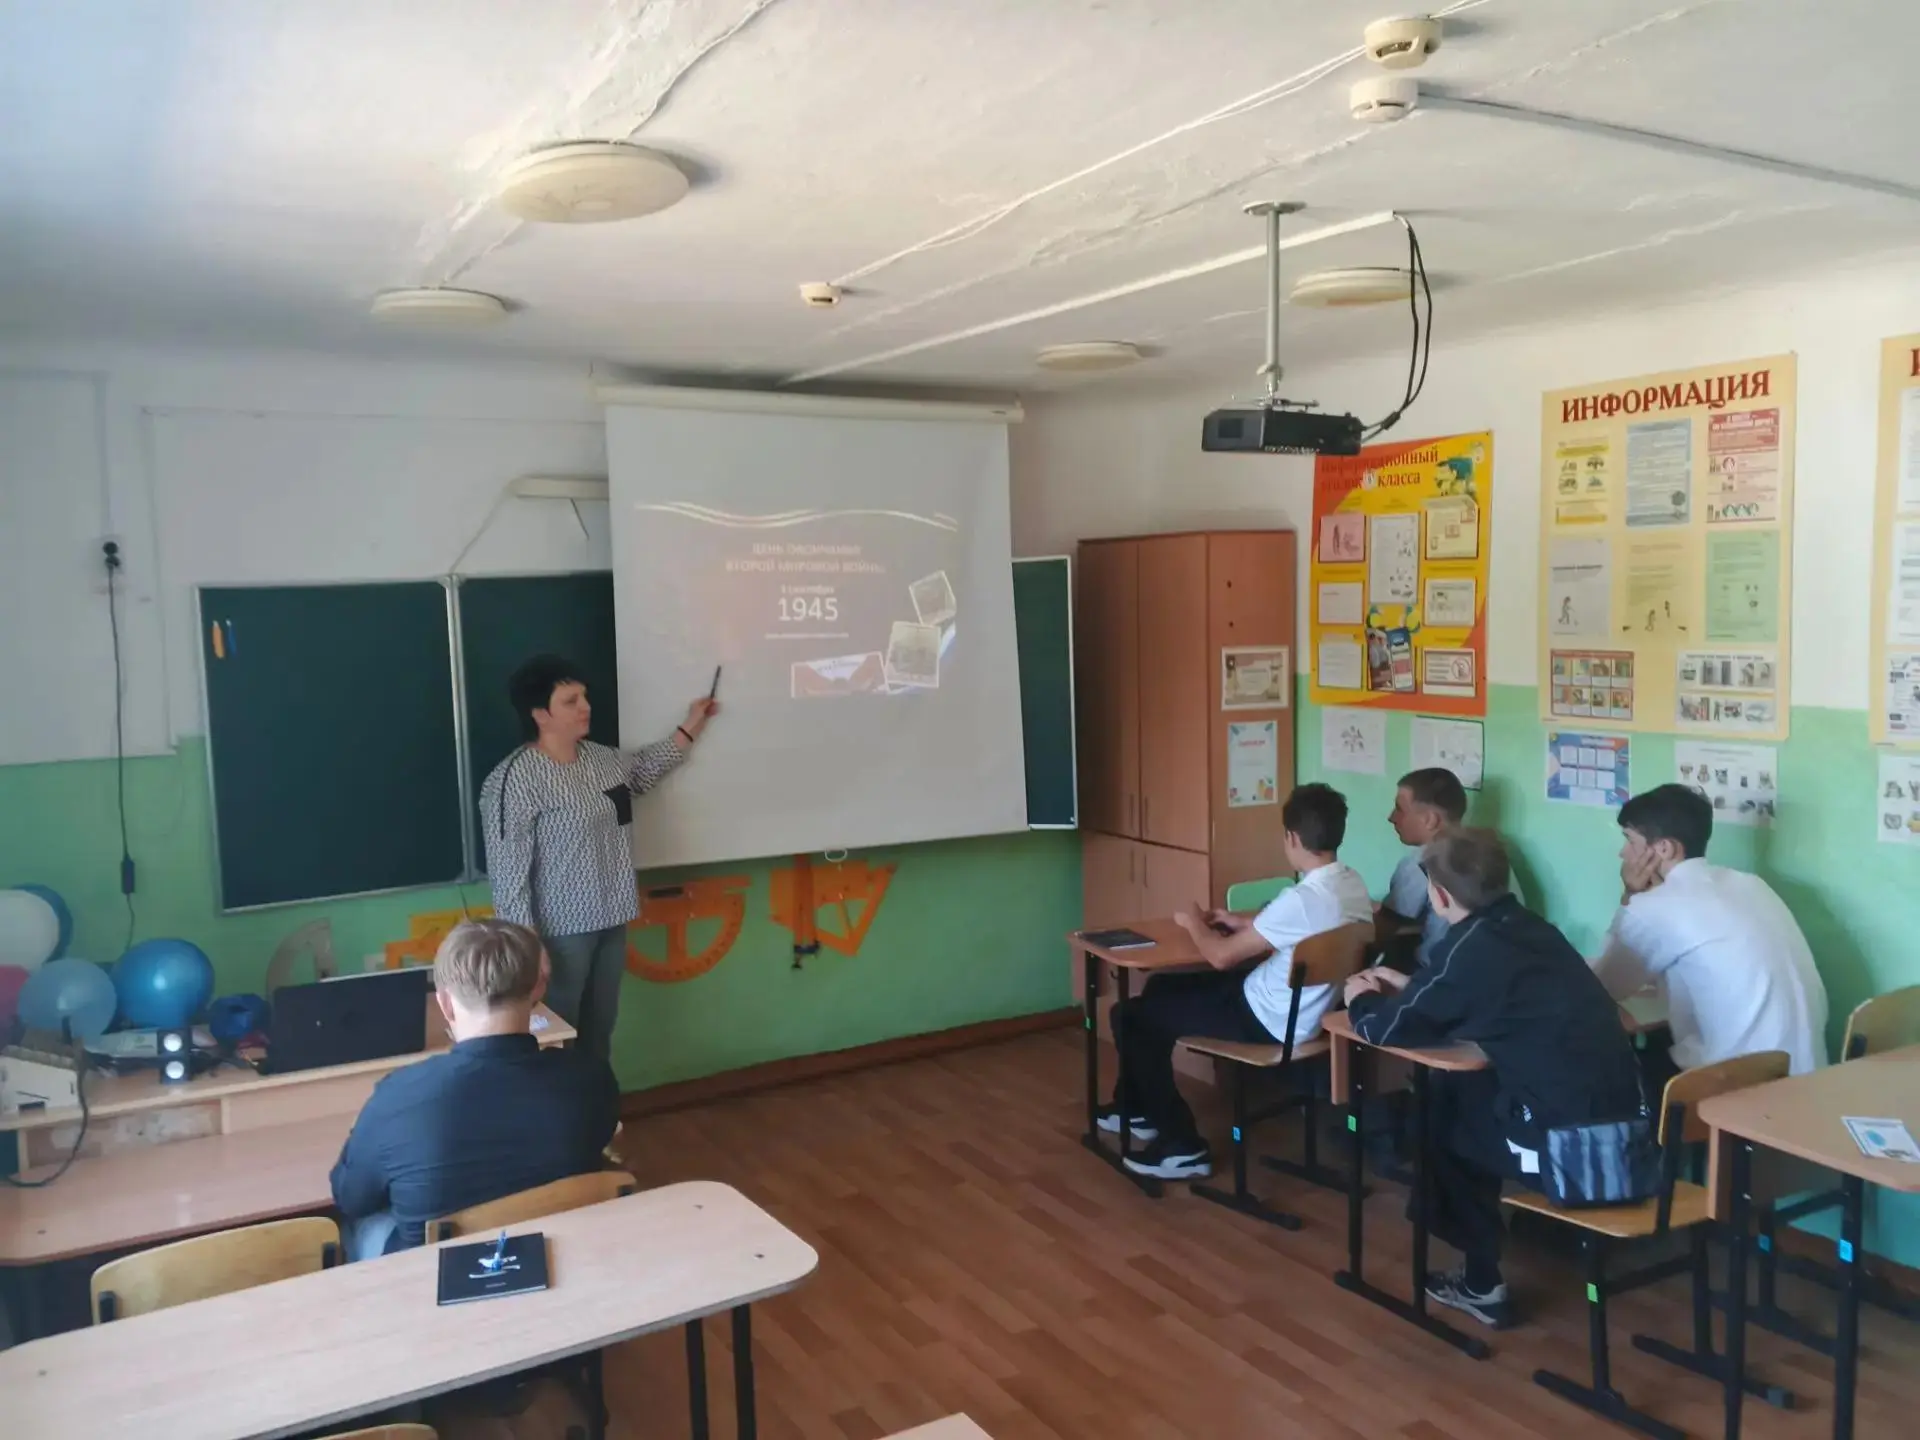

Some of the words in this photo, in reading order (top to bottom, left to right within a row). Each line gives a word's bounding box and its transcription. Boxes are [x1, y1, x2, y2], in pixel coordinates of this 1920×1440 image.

[1561, 369, 1771, 424] ИНФОРМАЦИЯ
[1377, 471, 1421, 488] класса
[725, 557, 775, 573] ВТОРОЙ
[777, 597, 839, 622] 1945
